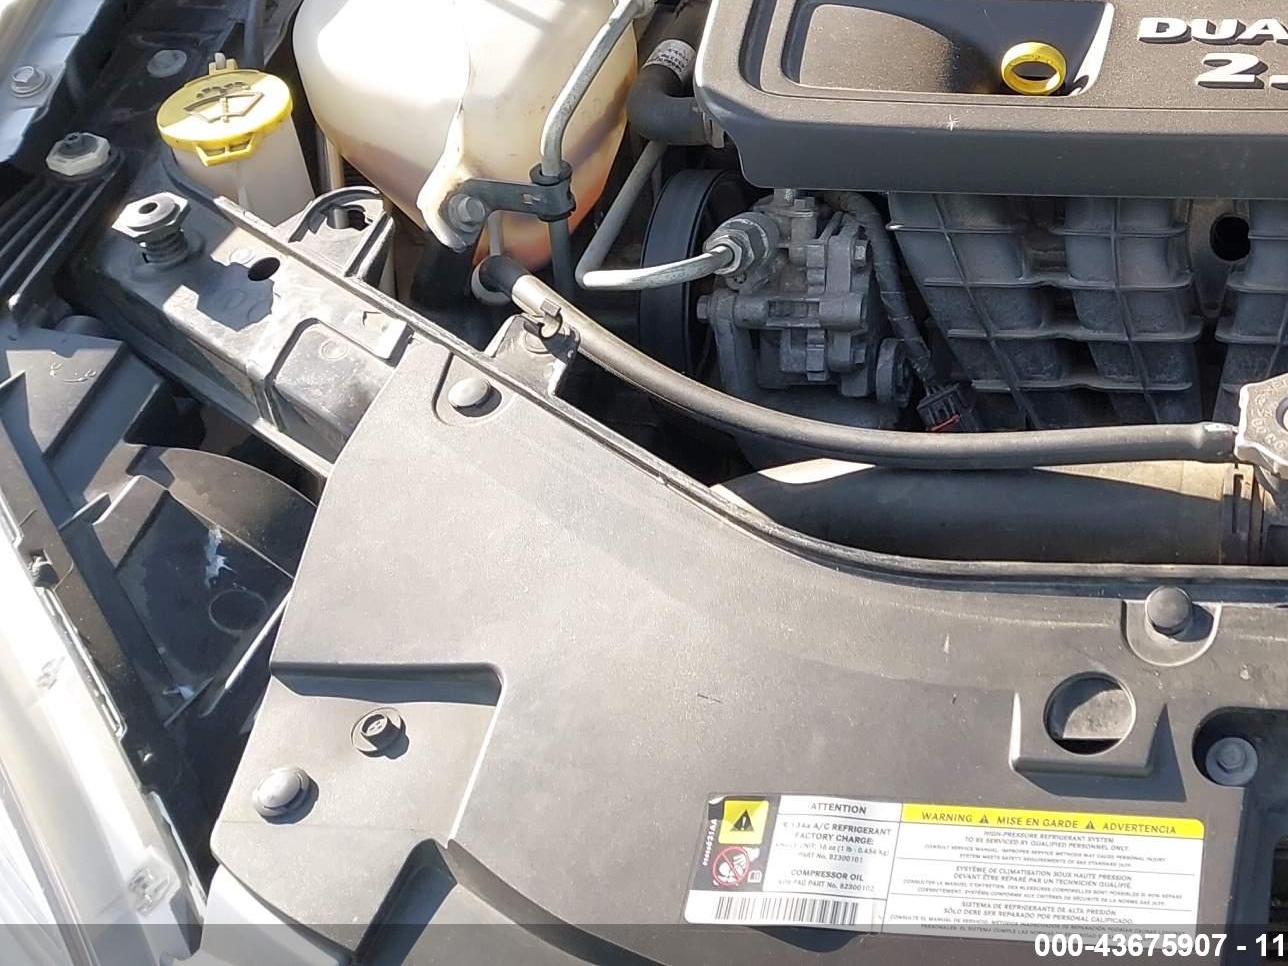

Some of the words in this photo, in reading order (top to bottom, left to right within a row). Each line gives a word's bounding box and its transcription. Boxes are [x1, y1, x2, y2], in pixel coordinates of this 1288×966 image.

[810, 802, 866, 815] ATTENTION
[921, 810, 972, 822] WARNING
[996, 815, 1022, 825] MISE
[1026, 817, 1039, 826] EN
[1043, 817, 1078, 828] GARDE
[1102, 821, 1176, 834] ADVERTENCIA
[832, 823, 892, 835] REFRIGERANT
[795, 833, 834, 841] FACTORY
[836, 835, 874, 845] CHARGE:
[985, 837, 1018, 845] SERVICED
[1030, 839, 1066, 848] QUALIFIED
[1068, 841, 1108, 850] PERSONNEL
[790, 869, 848, 880] COMPRESSOR
[850, 874, 864, 882] OIL
[953, 871, 980, 880] DEVANT
[1055, 877, 1096, 886] TECHNICIEN
[998, 866, 1050, 876] CLIMATISATION
[1073, 871, 1095, 879] HAUTE
[1098, 872, 1131, 881] PRESSION
[961, 900, 991, 908] SISTEMA
